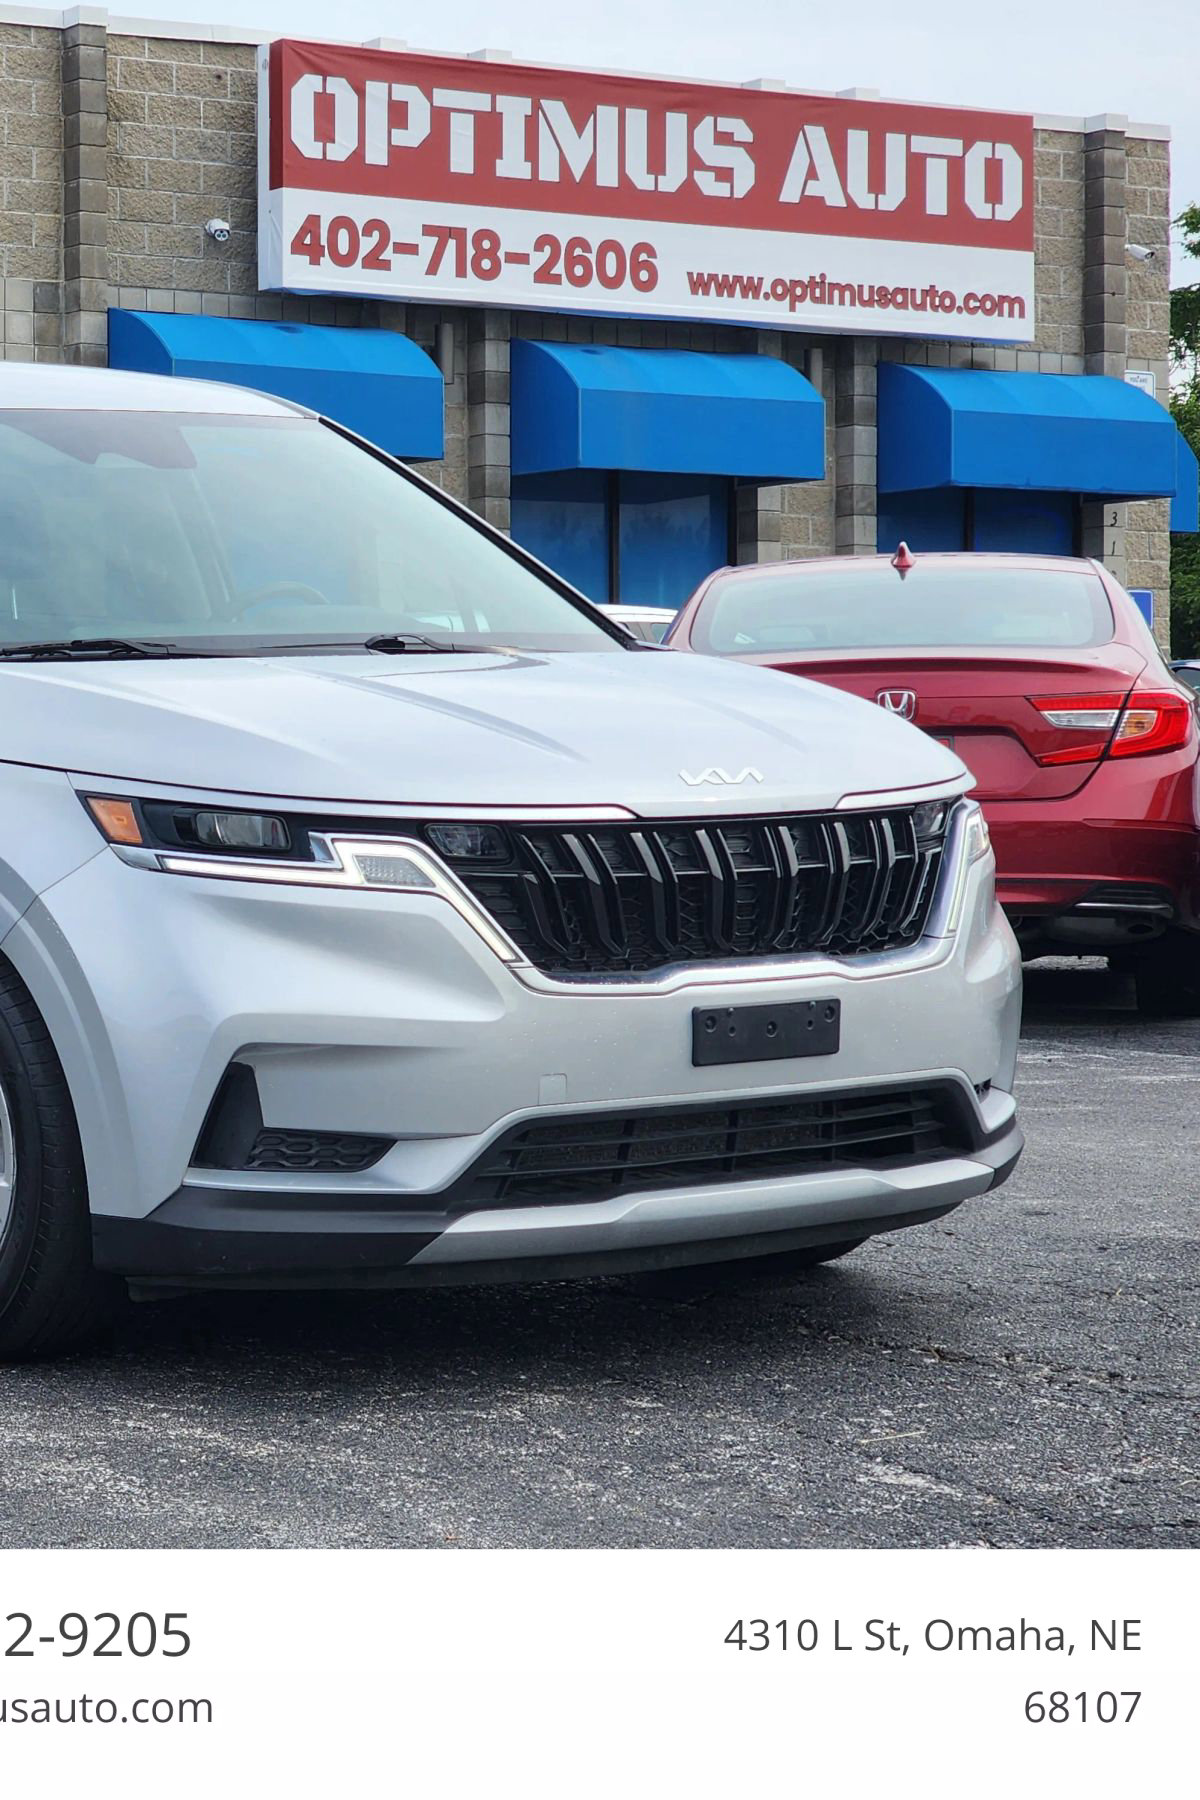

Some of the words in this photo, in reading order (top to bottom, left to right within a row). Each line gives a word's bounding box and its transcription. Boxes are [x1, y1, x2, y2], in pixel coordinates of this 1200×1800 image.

[290, 73, 756, 200] OPTIMUS
[778, 124, 1023, 222] AUTO
[290, 213, 659, 293] 402-718-2606
[686, 272, 1026, 319] www.optimusauto.com
